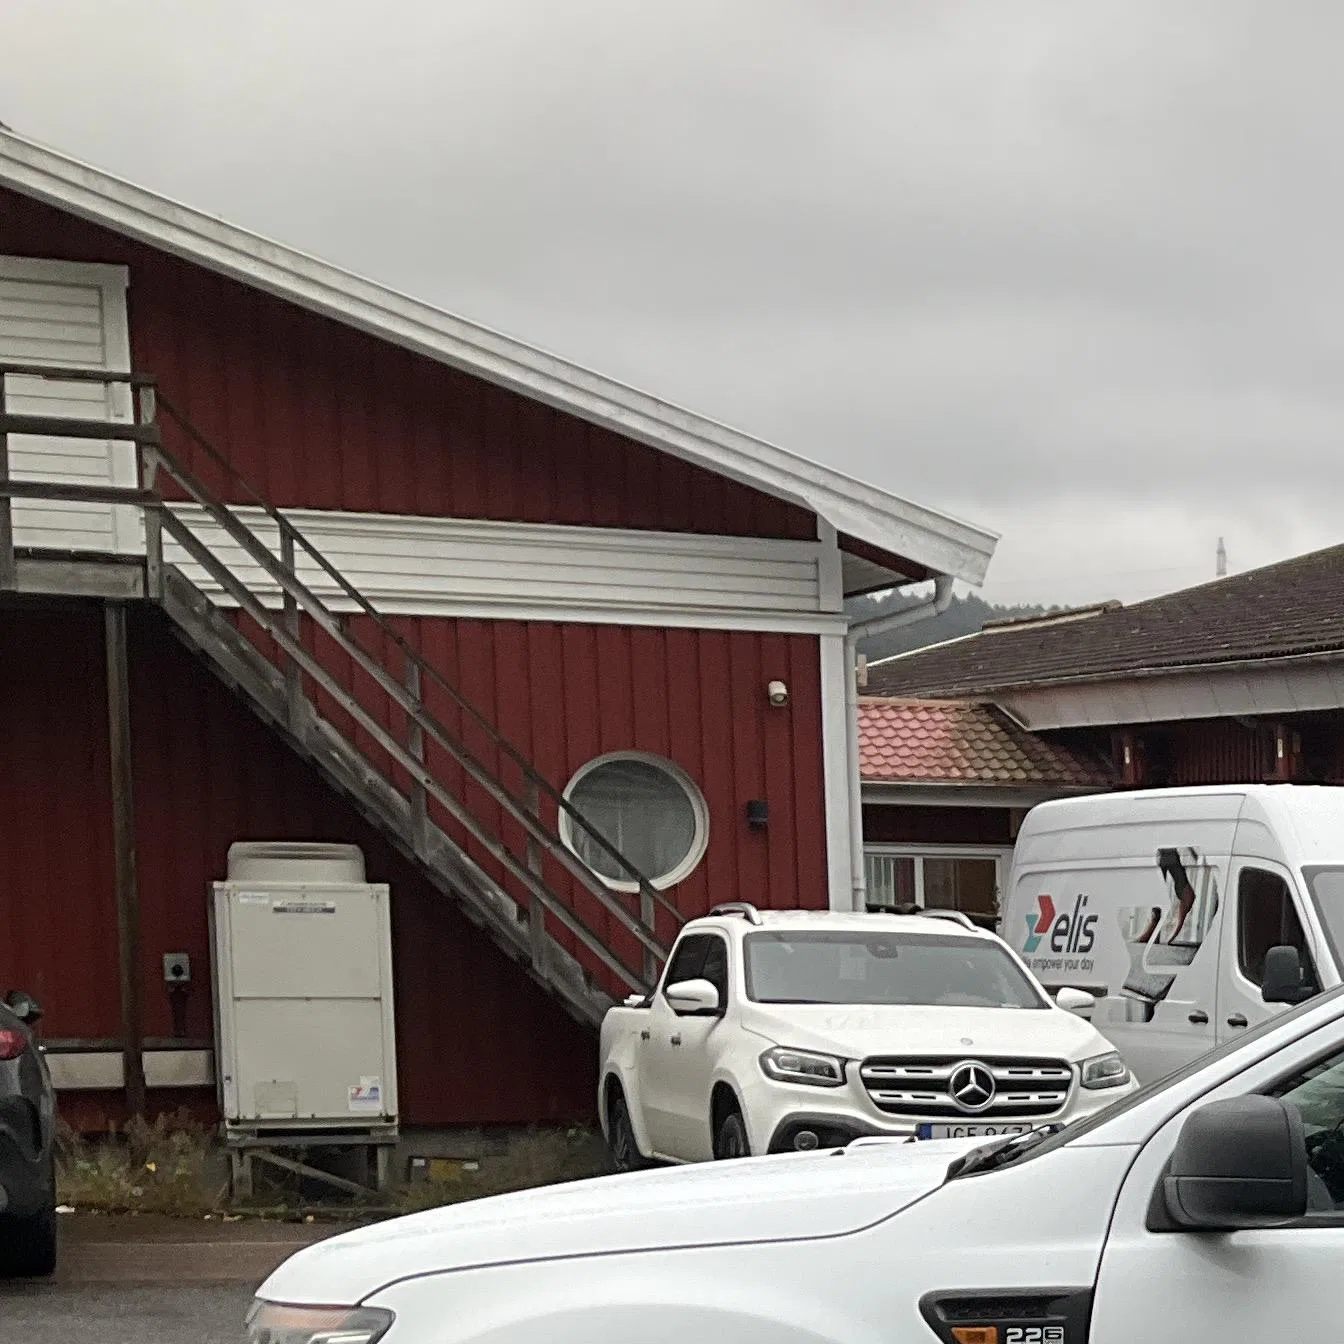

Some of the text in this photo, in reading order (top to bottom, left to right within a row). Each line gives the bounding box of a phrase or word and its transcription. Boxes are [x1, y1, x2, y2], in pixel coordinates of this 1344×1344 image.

[1051, 893, 1099, 953] elis
[1064, 958, 1080, 972] your
[1081, 957, 1095, 973] day
